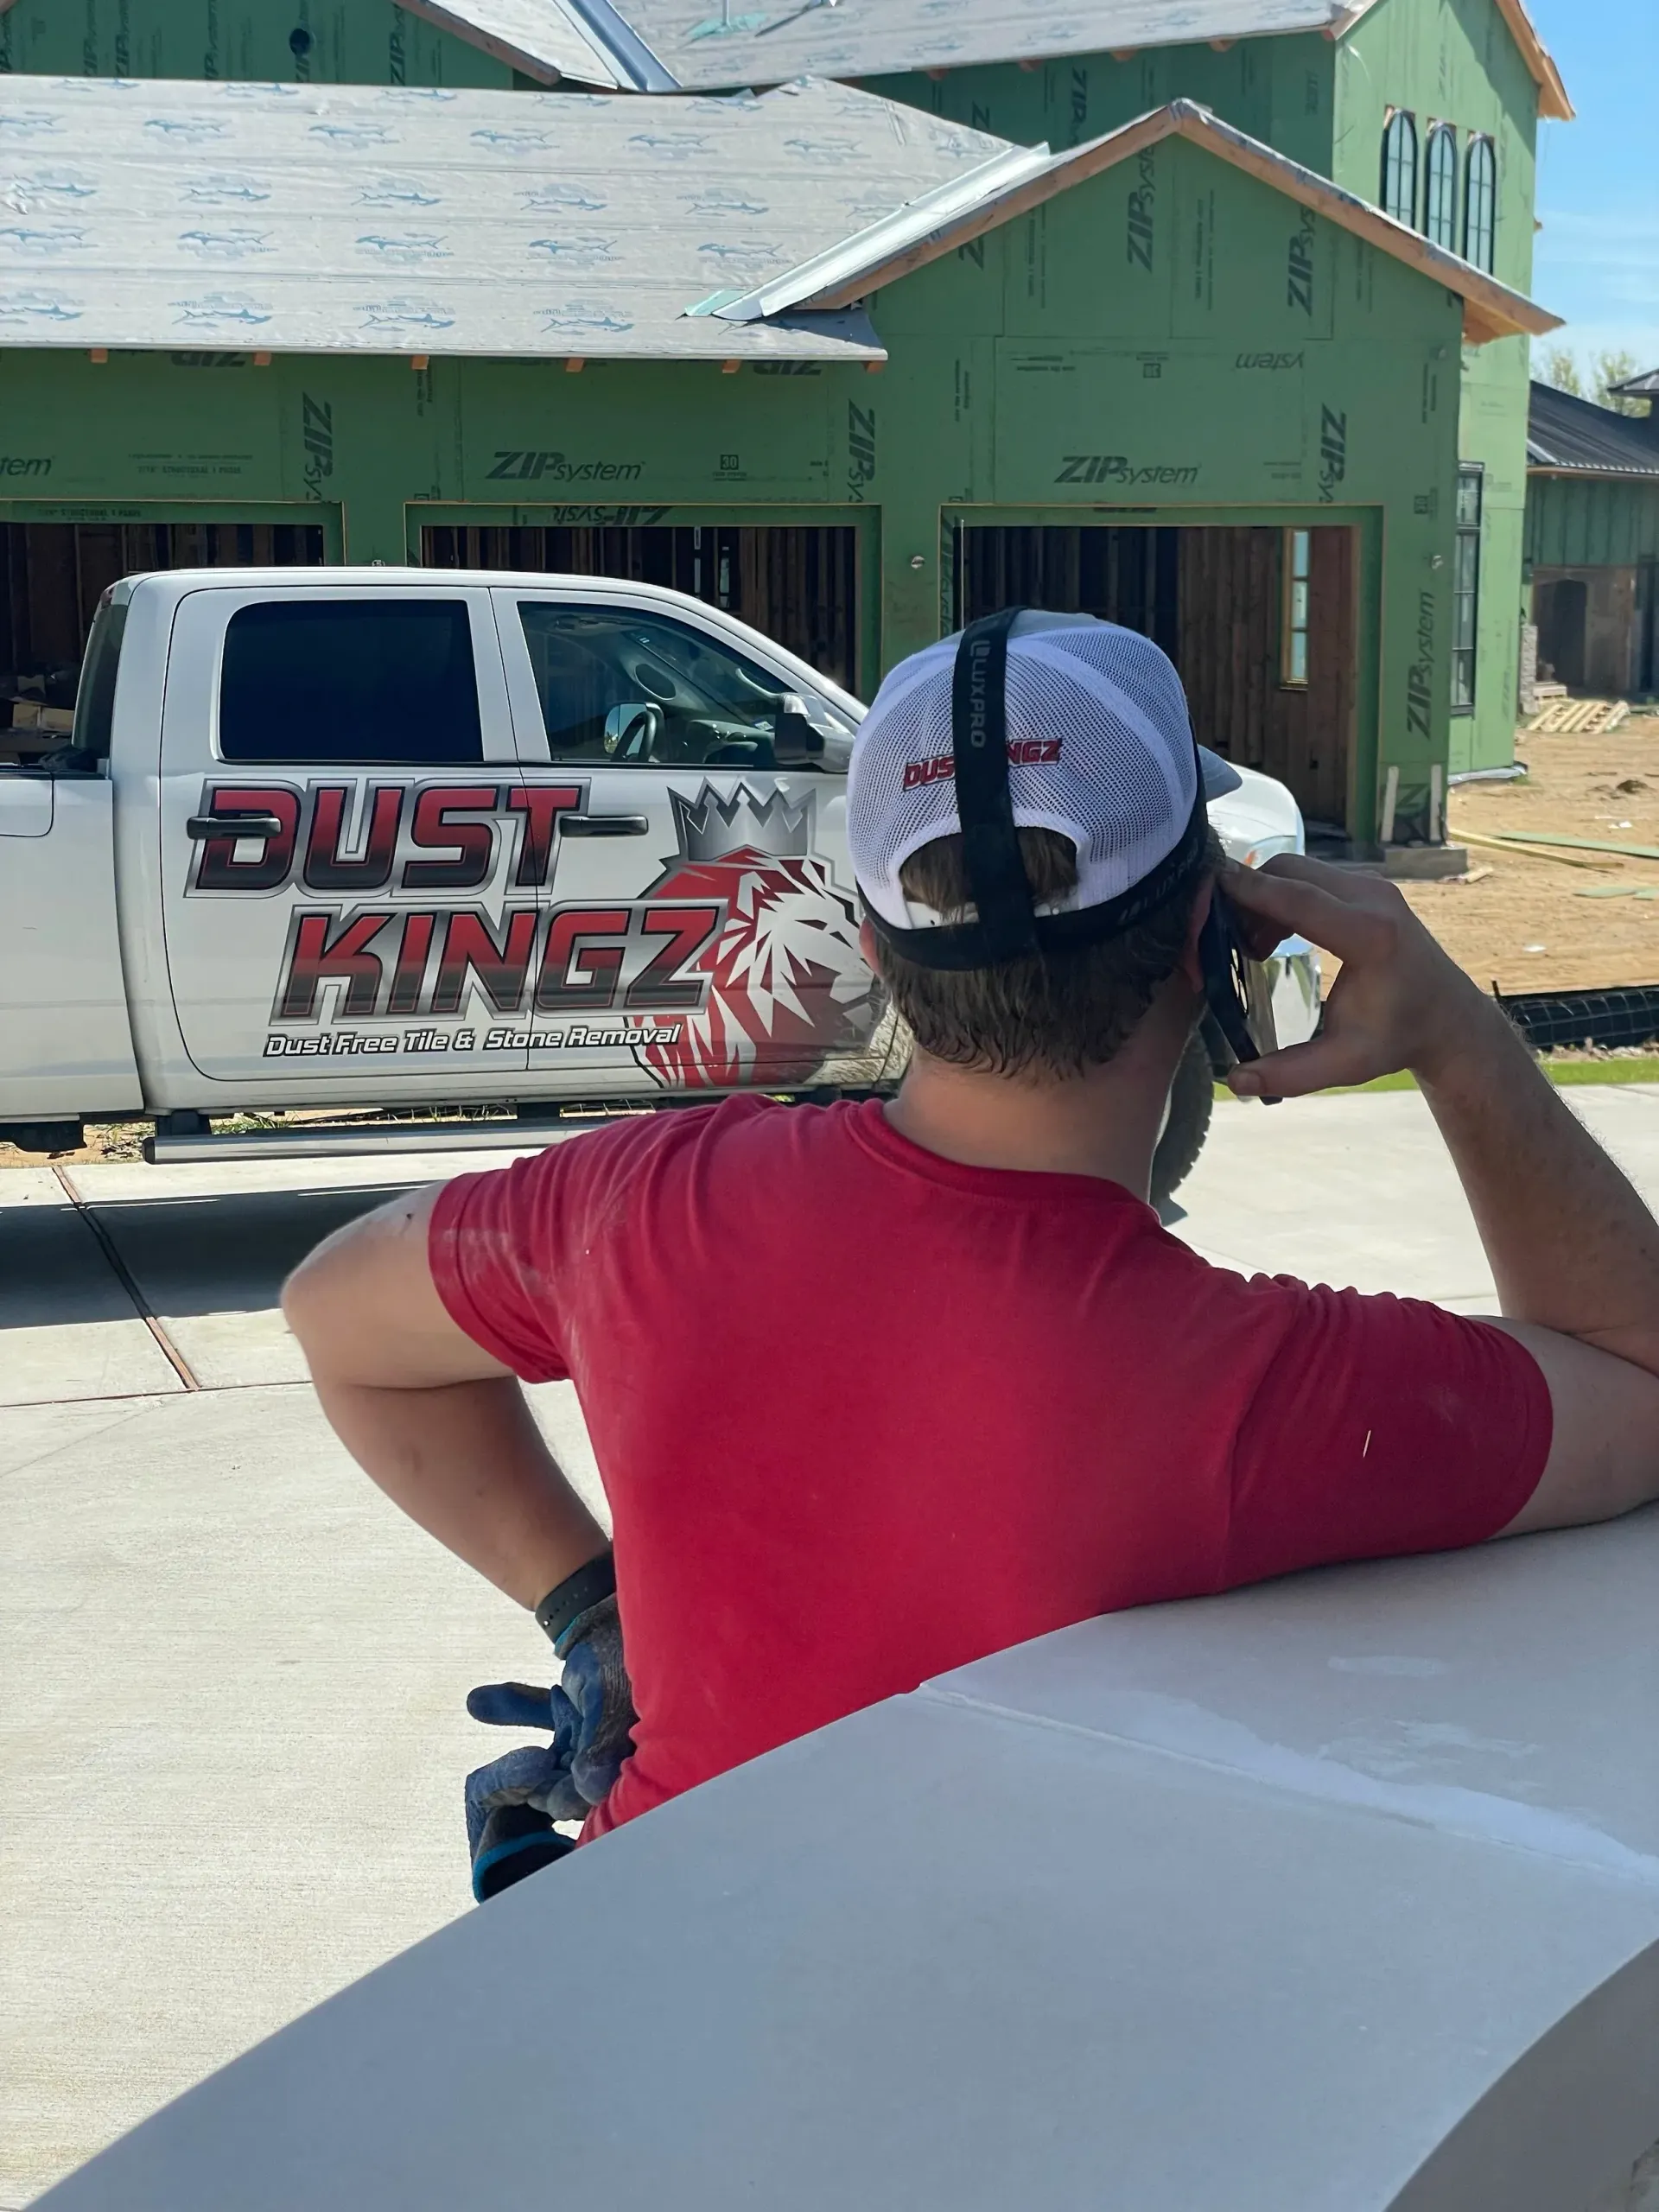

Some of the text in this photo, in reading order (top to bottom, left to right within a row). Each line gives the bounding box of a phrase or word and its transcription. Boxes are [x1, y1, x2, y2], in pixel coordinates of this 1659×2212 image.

[969, 658, 987, 748] LUXPRO
[904, 754, 956, 791] DUS
[188, 781, 588, 896] DUST
[273, 902, 726, 1021] KINGZ
[264, 1024, 682, 1056] Dust Free Tile & Stone Removal
